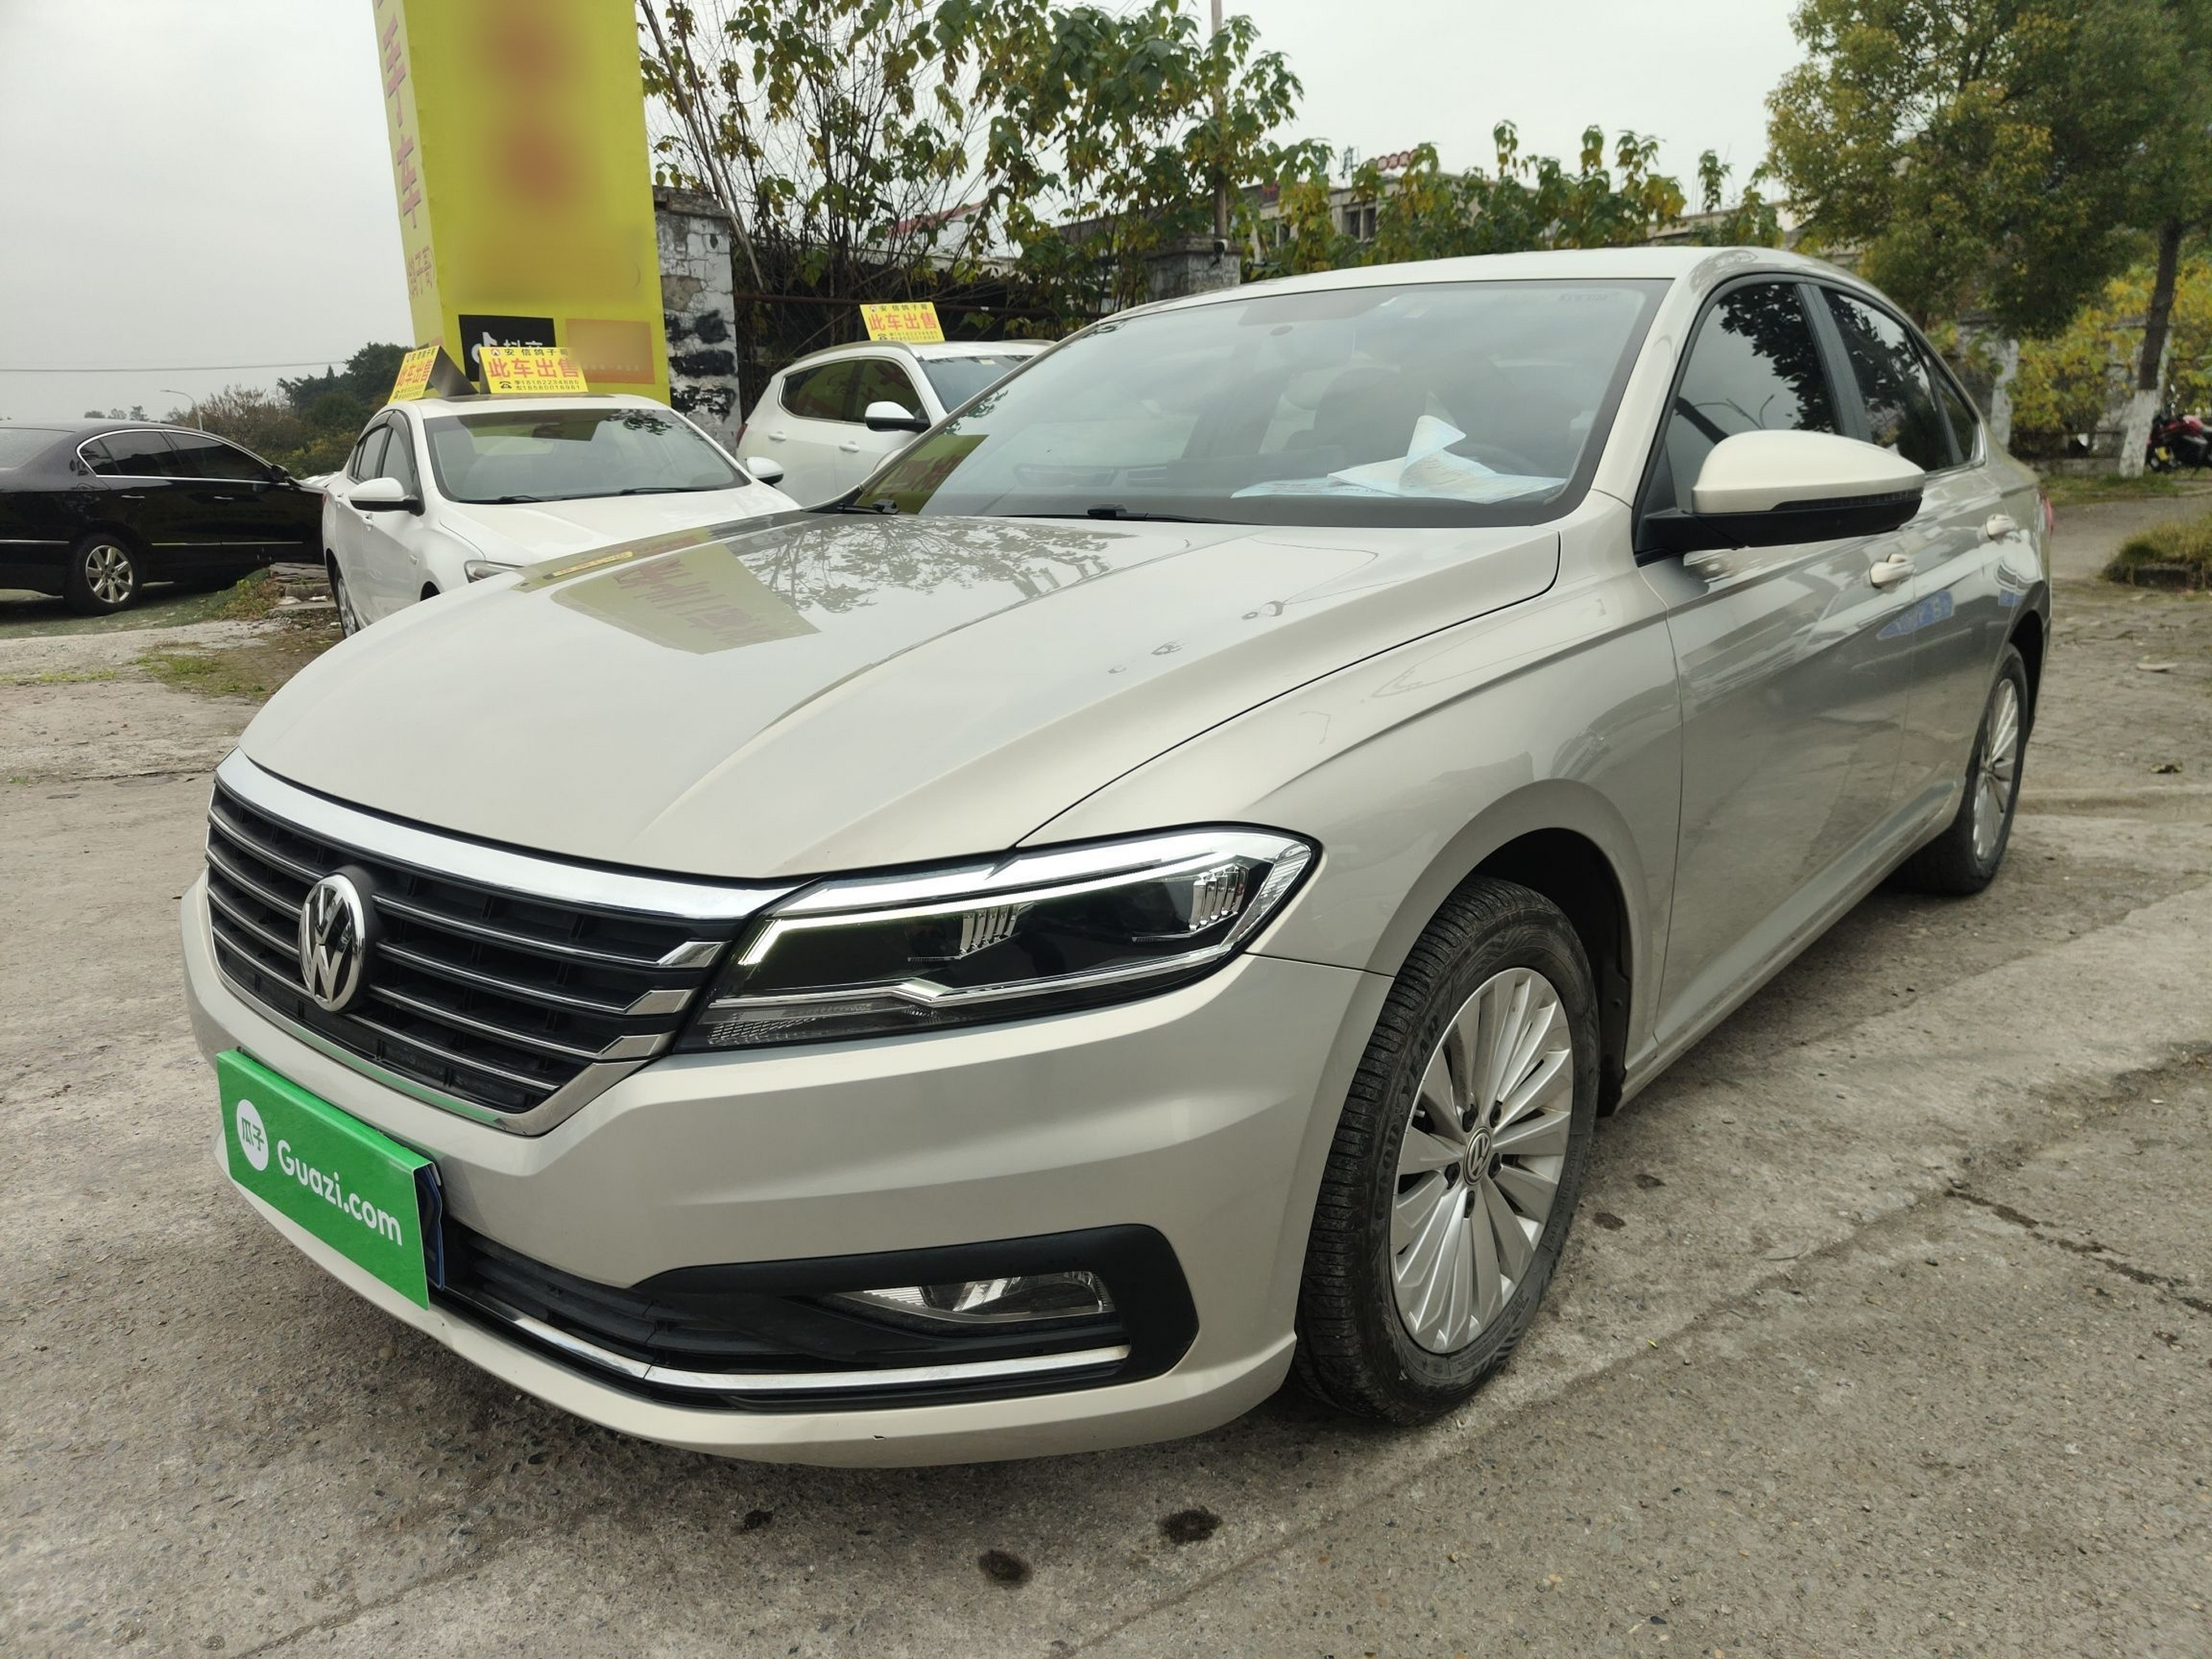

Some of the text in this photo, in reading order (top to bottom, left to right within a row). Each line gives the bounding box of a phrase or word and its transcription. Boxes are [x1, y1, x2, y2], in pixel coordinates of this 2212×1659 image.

[868, 312, 937, 331] 此车出售
[488, 358, 579, 378] 此车出售
[241, 1117, 264, 1152] 瓜子
[278, 1139, 403, 1246] Guazi.com
